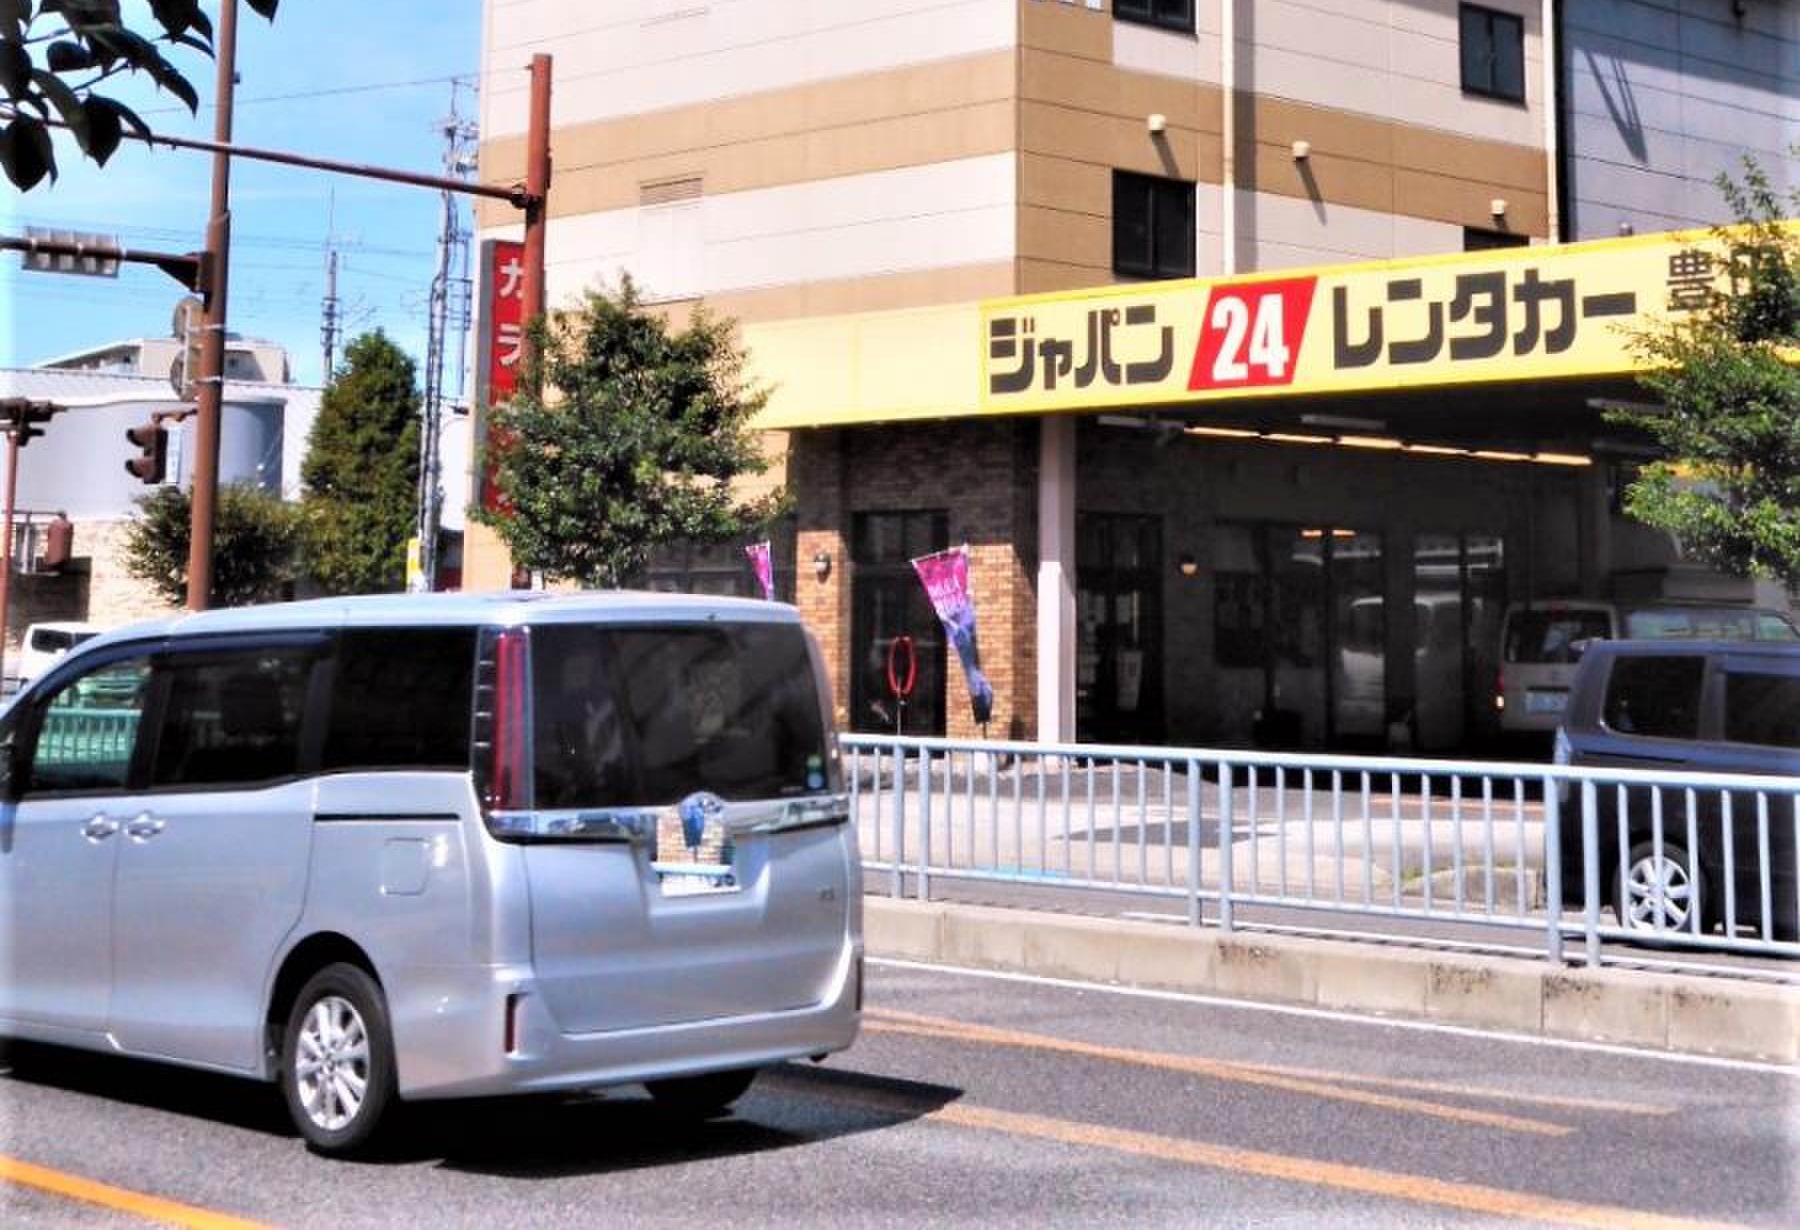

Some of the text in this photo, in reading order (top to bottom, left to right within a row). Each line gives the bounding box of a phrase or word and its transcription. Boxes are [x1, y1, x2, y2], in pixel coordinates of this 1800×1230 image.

[990, 305, 1174, 394] ジャパン
[1211, 294, 1290, 381] 24
[1333, 268, 1636, 370] レンタカー
